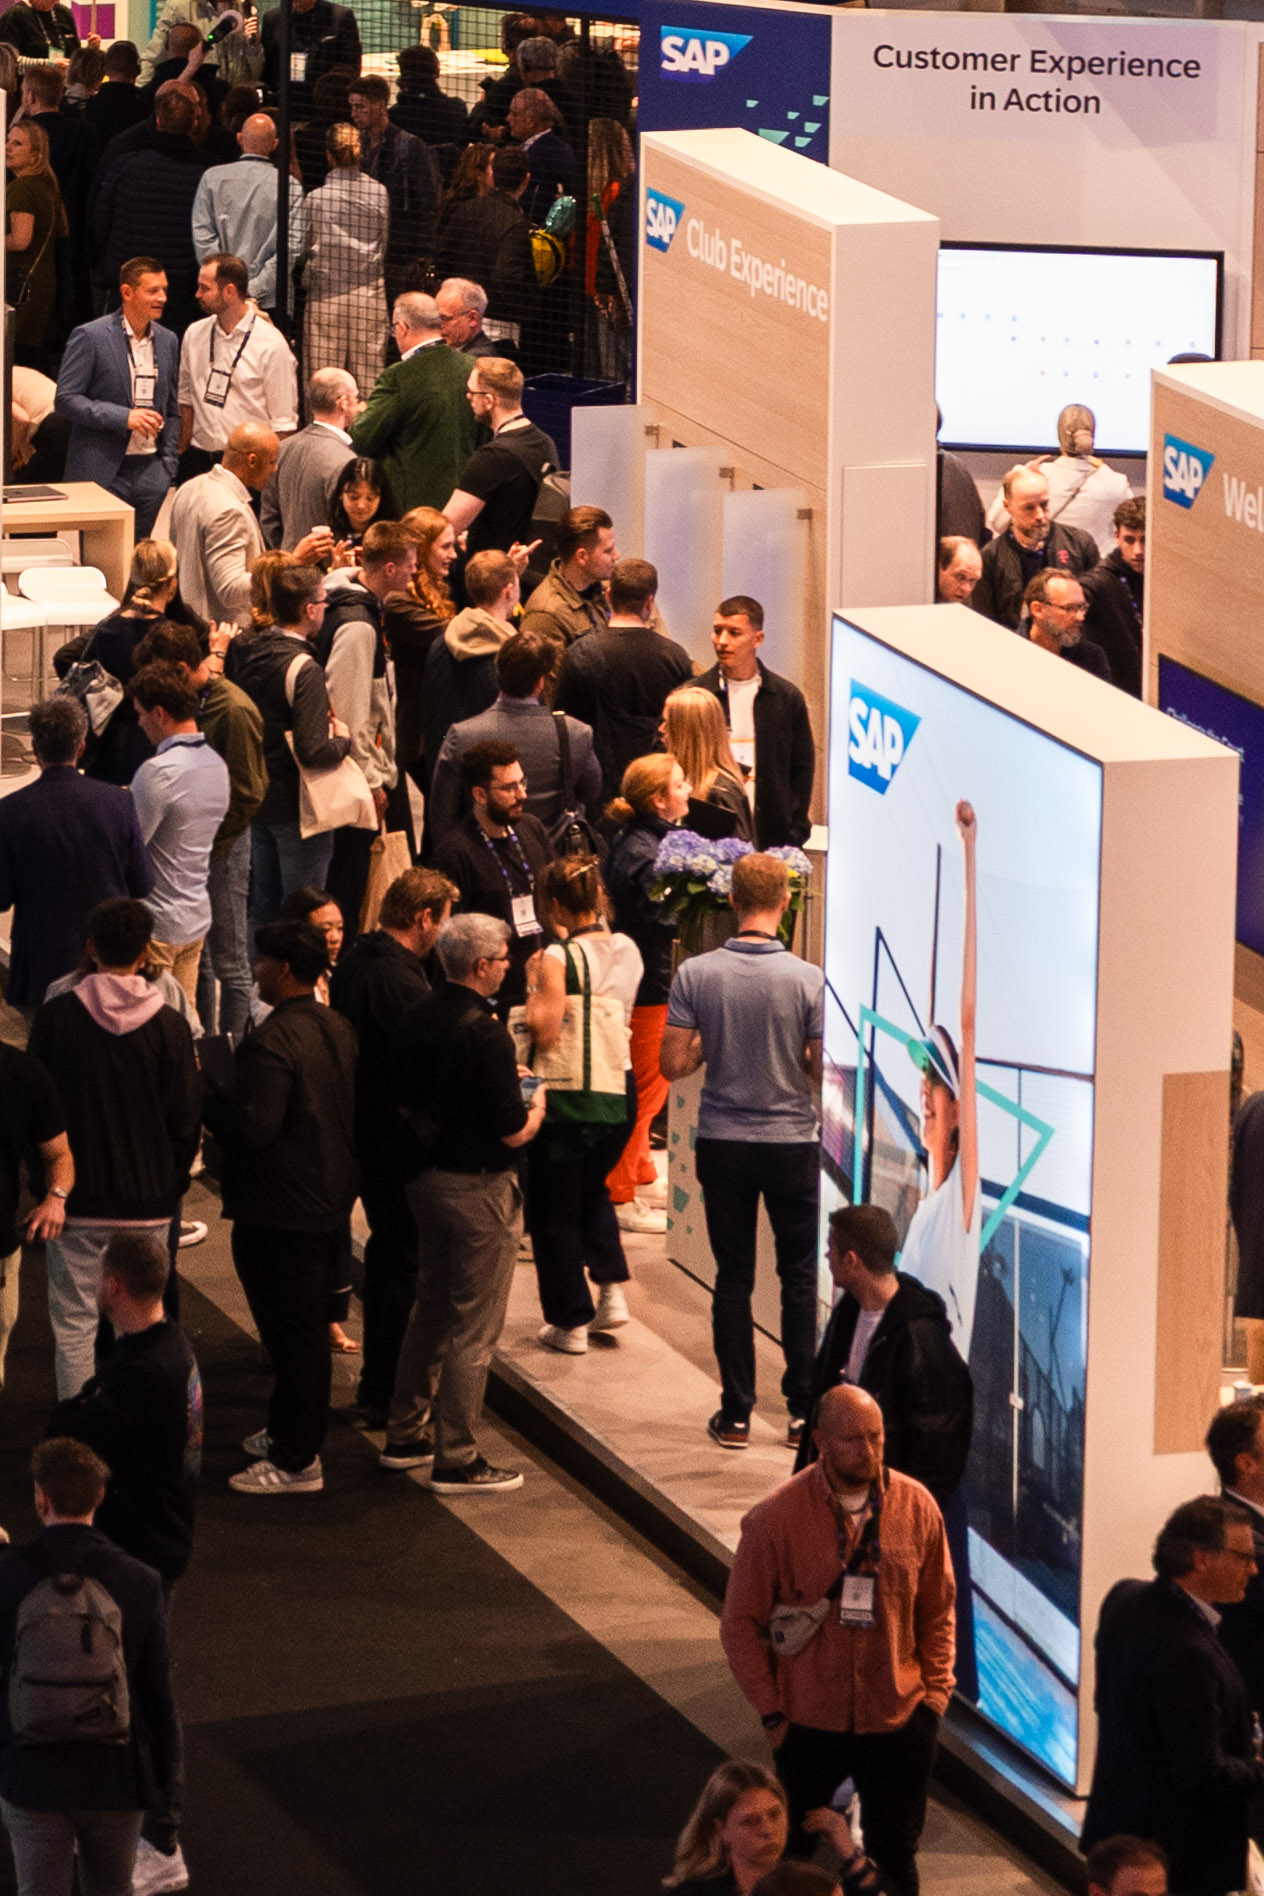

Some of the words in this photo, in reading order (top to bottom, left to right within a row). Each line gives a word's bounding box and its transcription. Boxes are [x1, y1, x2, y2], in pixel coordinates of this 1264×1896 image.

[659, 37, 731, 76] SAP
[873, 45, 1021, 74] Customer
[1030, 49, 1202, 81] Experience
[970, 84, 996, 111] in
[1004, 87, 1101, 114] Action
[646, 196, 676, 244] SAP
[686, 218, 726, 272] Club
[730, 238, 829, 322] Experience
[1164, 445, 1203, 500] SAP
[1223, 472, 1264, 533] Wel
[848, 696, 904, 781] SAP
